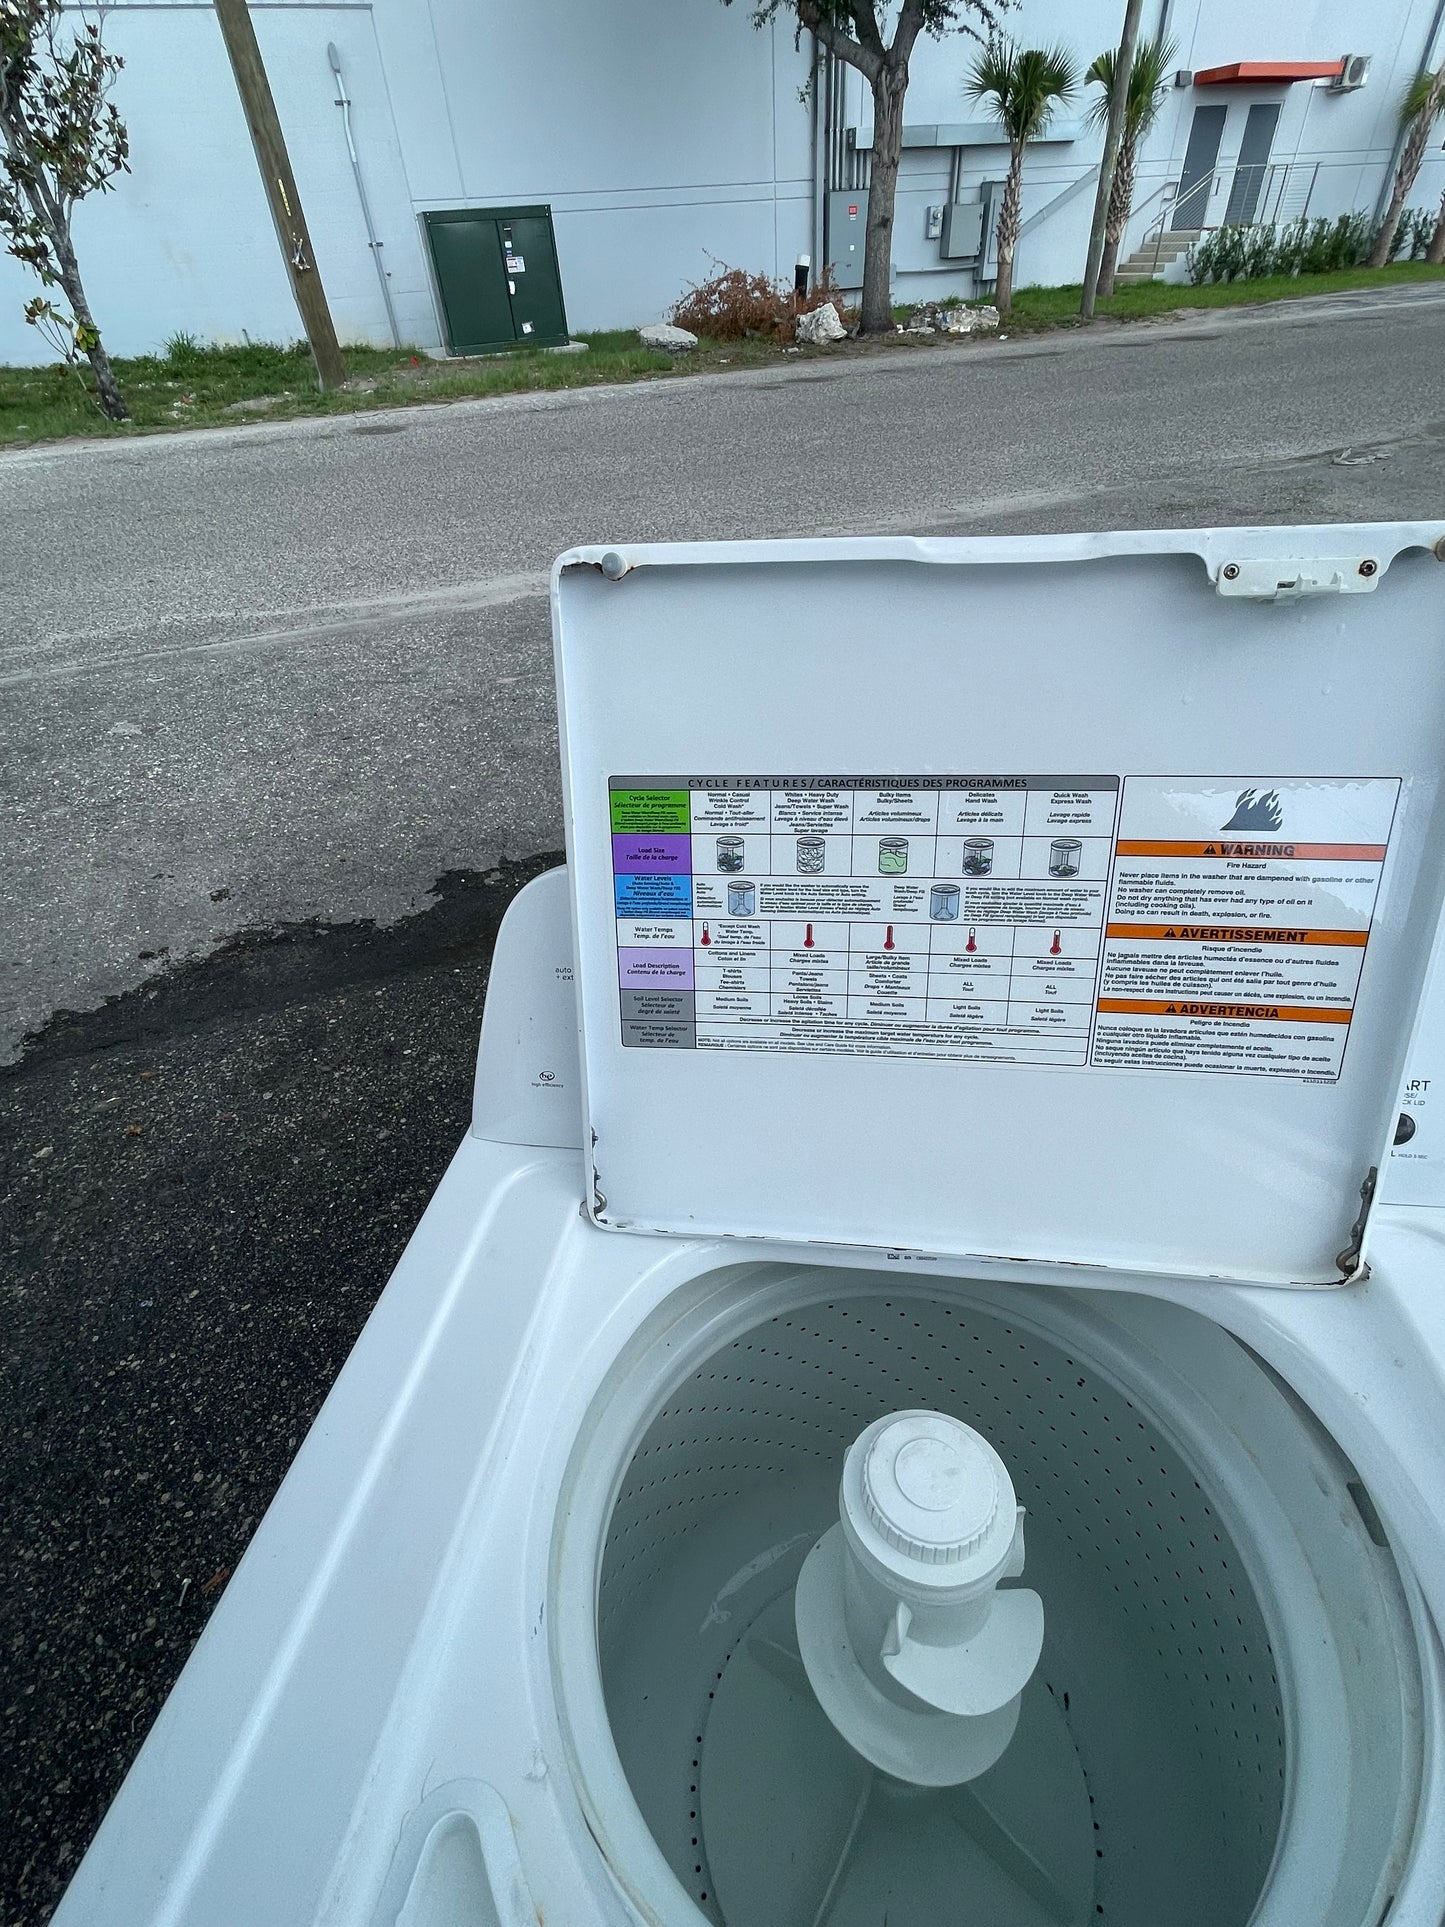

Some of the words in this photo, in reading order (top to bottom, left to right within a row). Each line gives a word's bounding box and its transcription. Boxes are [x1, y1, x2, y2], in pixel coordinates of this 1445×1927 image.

[688, 780, 729, 788] CYCLE
[922, 779, 942, 788] DES
[945, 779, 1027, 787] PROGRAMMES
[1220, 844, 1295, 856] WARNING
[1140, 872, 1160, 880] place
[1180, 928, 1308, 942] AVERTISSEMENT
[1180, 1005, 1279, 1018] ADVERTENCIA
